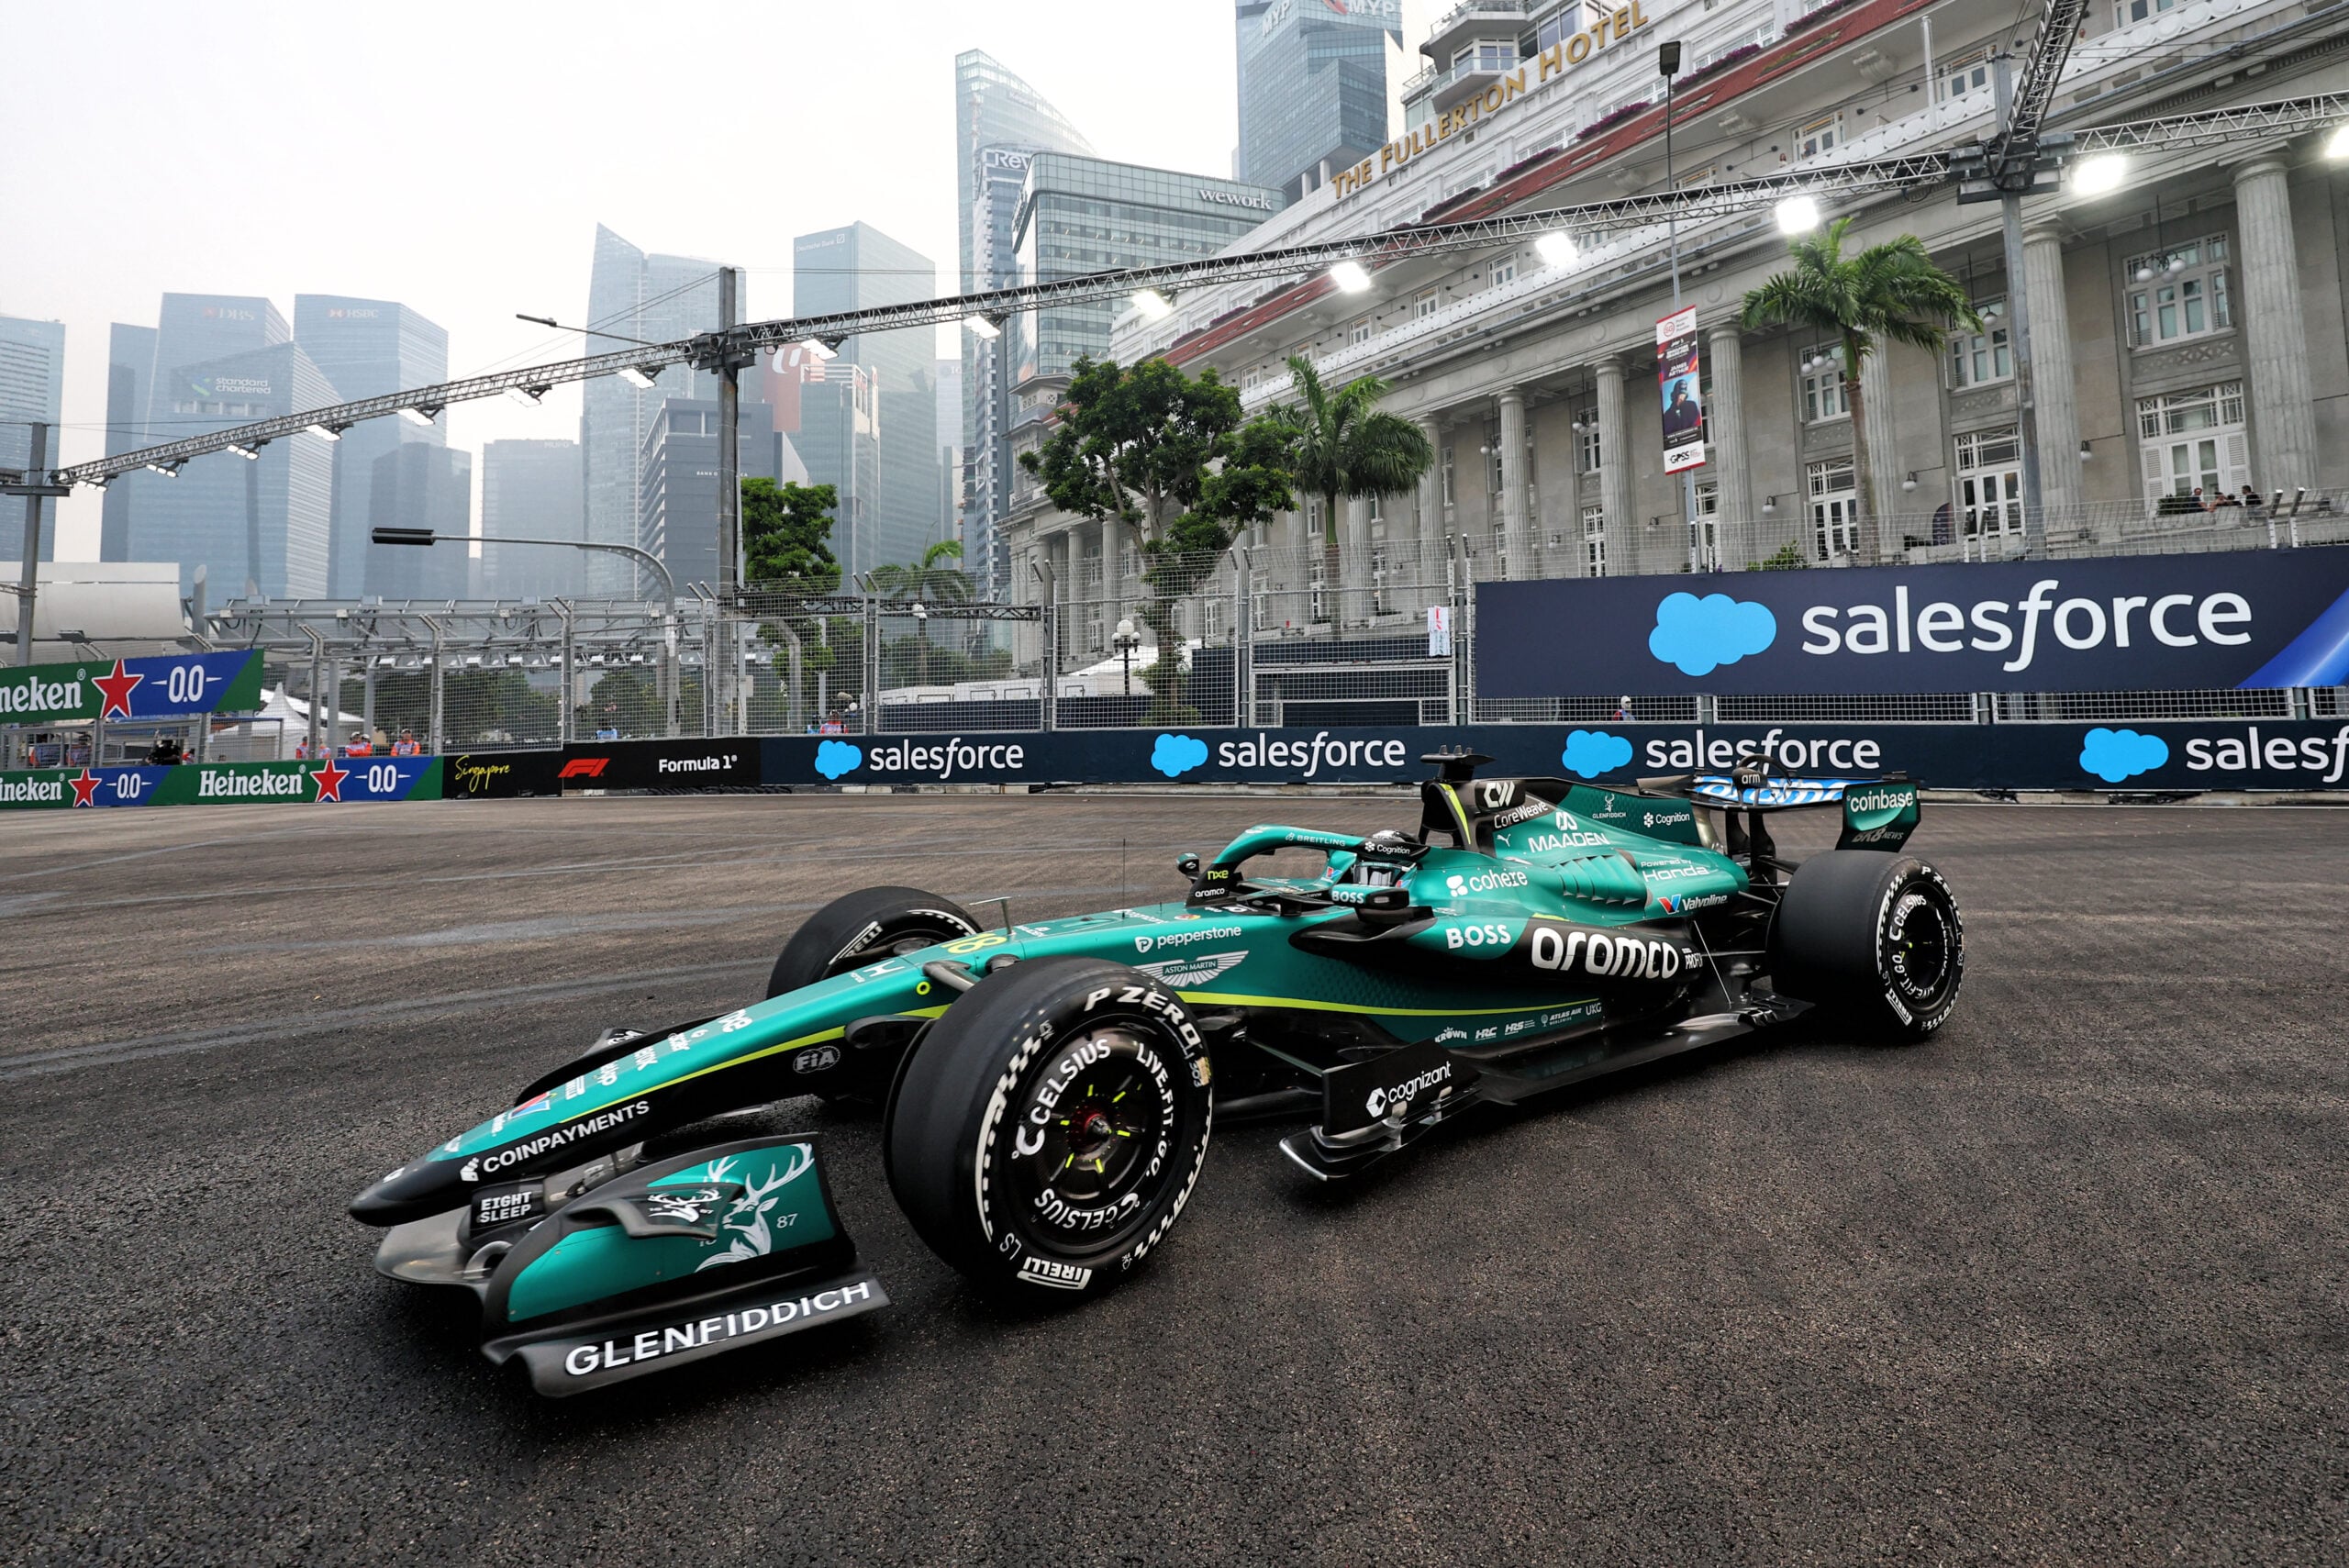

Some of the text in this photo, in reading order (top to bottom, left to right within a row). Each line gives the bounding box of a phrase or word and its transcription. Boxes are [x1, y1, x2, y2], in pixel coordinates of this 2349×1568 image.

[1330, 0, 1649, 199] THE FULLERTON HOTEL
[1199, 189, 1272, 210] wework
[348, 308, 379, 319] HSBC
[216, 377, 268, 386] standard
[216, 385, 272, 395] chartered
[1802, 579, 2253, 673] salesforce
[869, 739, 1024, 779] salesforce
[1218, 731, 1406, 776] salesforce
[1646, 729, 1880, 773] salesforce
[454, 755, 510, 792] Singapore
[659, 756, 718, 773] Formula
[199, 769, 303, 797] Heineken
[1741, 773, 1760, 784] arm
[1850, 789, 1913, 813] coinbase
[1494, 801, 1548, 828] CoreWeave
[1655, 812, 1690, 826] Cognition
[1297, 835, 1346, 847] BREITLING
[1377, 844, 1410, 854] Cognition
[1528, 832, 1610, 852] MAADEN
[1641, 859, 1680, 868] Powered
[1642, 865, 1709, 882] Honda
[1207, 870, 1229, 880] nxe
[1469, 869, 1528, 892] cohere
[1195, 887, 1225, 898] aramco
[1331, 891, 1364, 904] BOSS
[1682, 895, 1728, 911] Valvoline
[1894, 895, 1927, 928] CELSIUS
[1157, 926, 1242, 949] pepperstone
[1445, 924, 1512, 950] BOSS
[1531, 927, 1679, 979] aramco
[1164, 961, 1217, 974] ASTON MARTIN
[1085, 985, 1202, 1048] P ZERO
[1549, 1007, 1583, 1021] ATLAS AIR
[1029, 1038, 1112, 1125] CELSIUS
[1388, 1061, 1453, 1104] cognizant
[483, 1101, 650, 1173] COINPAYMENTS
[481, 1192, 532, 1211] EIGHT
[1034, 1188, 1118, 1230] CELSIUS
[480, 1204, 532, 1223] SLEEP
[776, 1213, 798, 1229] 87
[1016, 1256, 1093, 1290] PIRELLI
[564, 1281, 870, 1377] GLENFIDDICH
